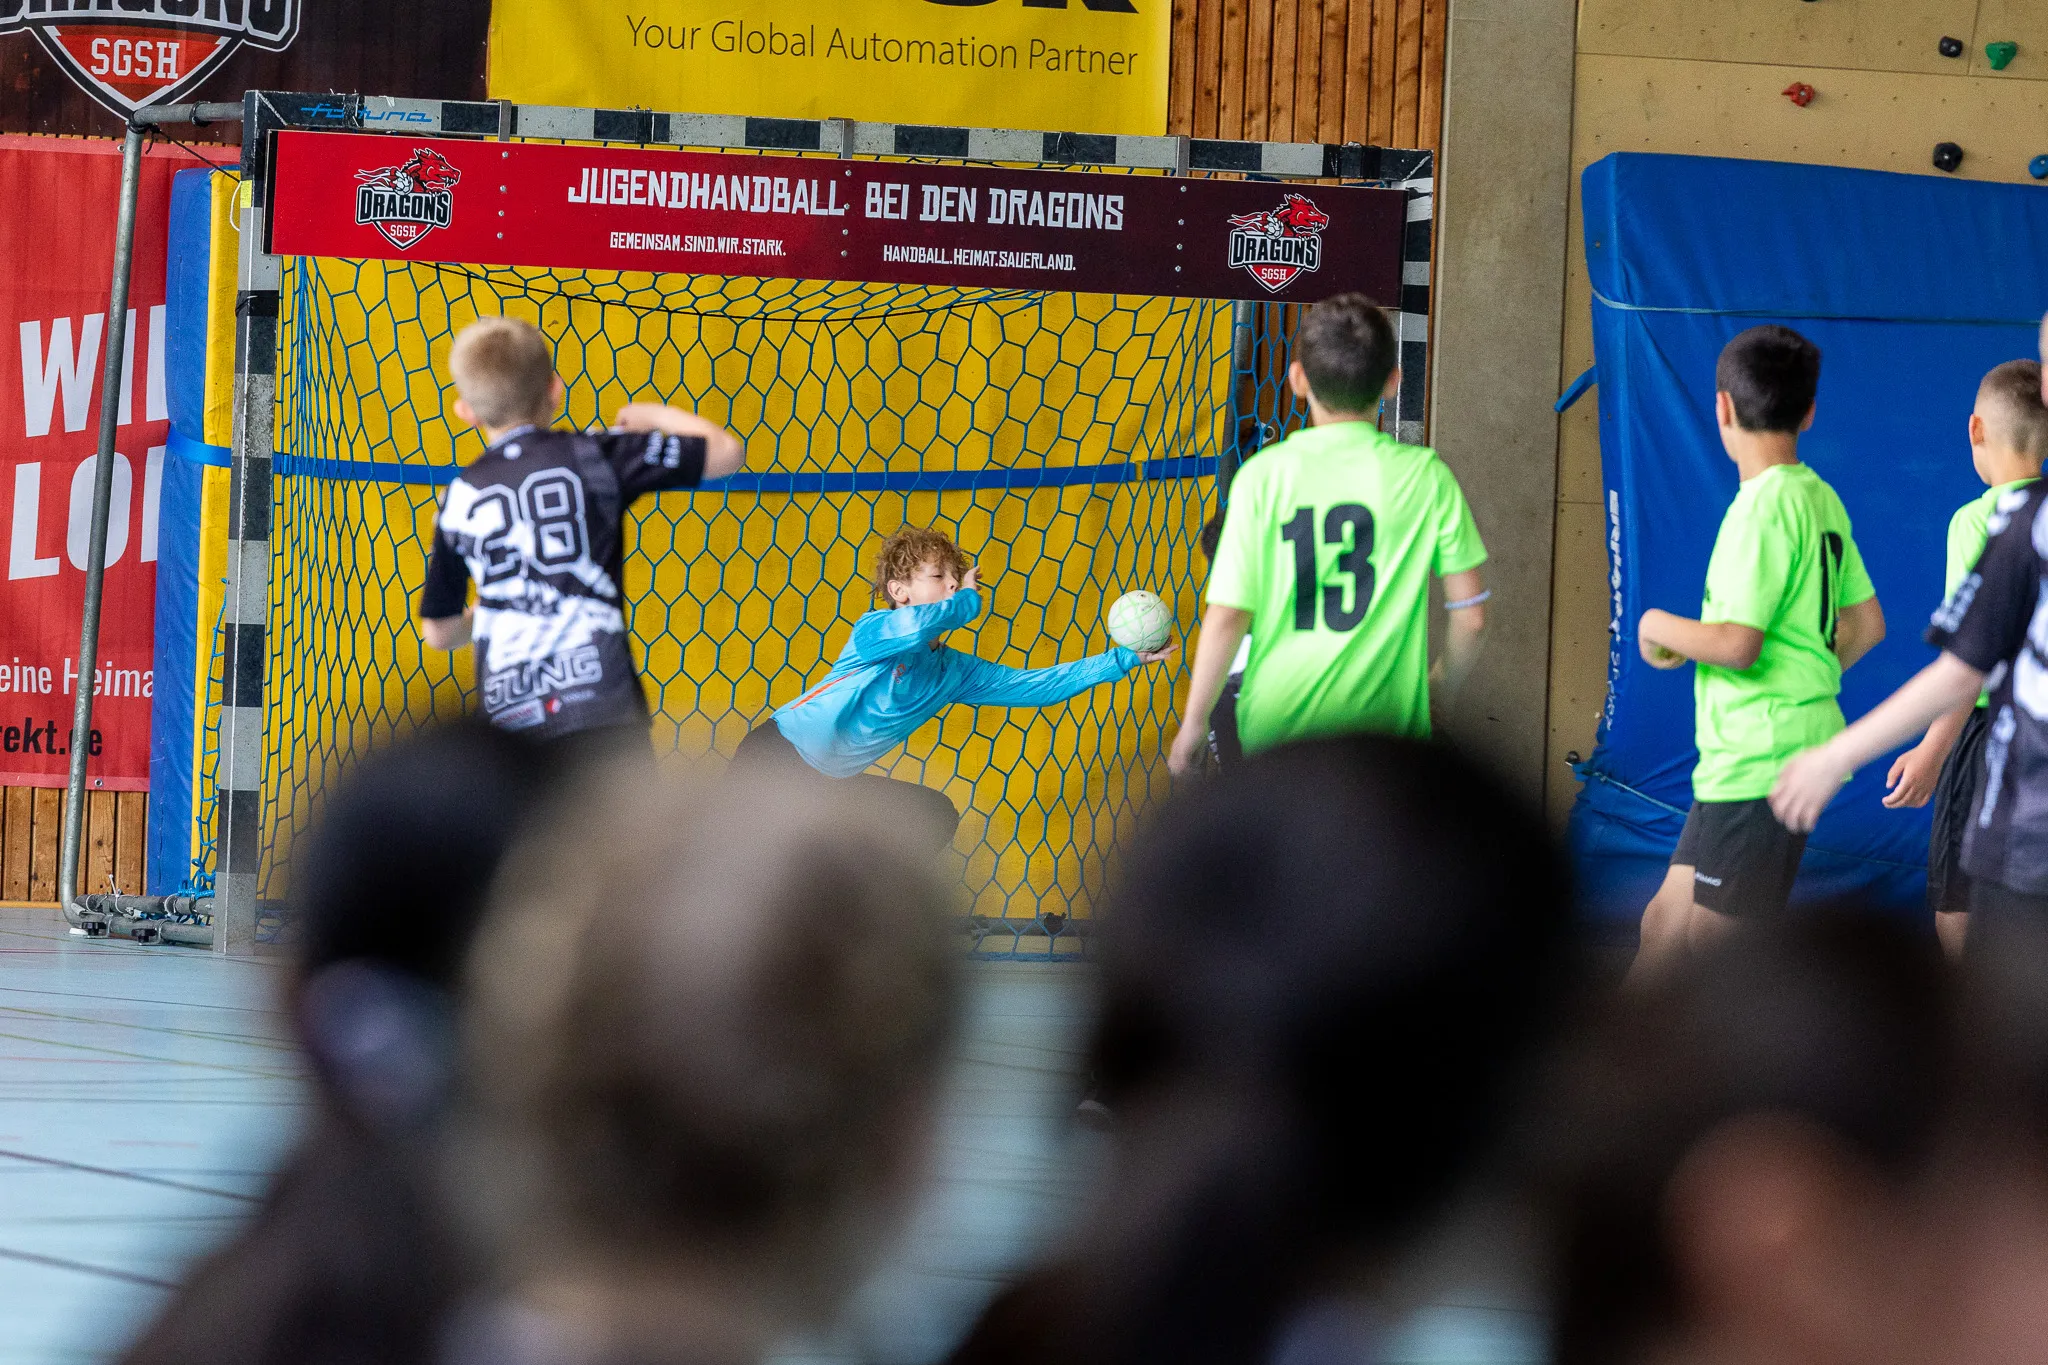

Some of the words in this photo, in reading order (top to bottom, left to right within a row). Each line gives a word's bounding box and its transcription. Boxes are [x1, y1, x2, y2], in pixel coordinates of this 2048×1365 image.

[90, 37, 180, 80] SGSH
[626, 15, 702, 50] Your
[711, 20, 815, 57] Global
[826, 28, 1018, 70] Automation
[1029, 38, 1138, 76] Partner
[359, 188, 450, 226] DRAGONS
[567, 167, 846, 217] JUGENDHANDBALL
[865, 181, 910, 221] BEI
[919, 184, 977, 223] DEN
[987, 187, 1124, 231] DRAGONS
[390, 224, 417, 238] SGSH
[609, 231, 787, 257] GEMEINSAM.SIND.WIR.STARK.
[883, 244, 1077, 271] HANDBALL.HEIMAT.SAUERLAND.
[1232, 233, 1318, 269] DRAGONS
[1261, 267, 1287, 280] SGSH
[466, 466, 592, 586] 28
[1282, 503, 1376, 632] 13
